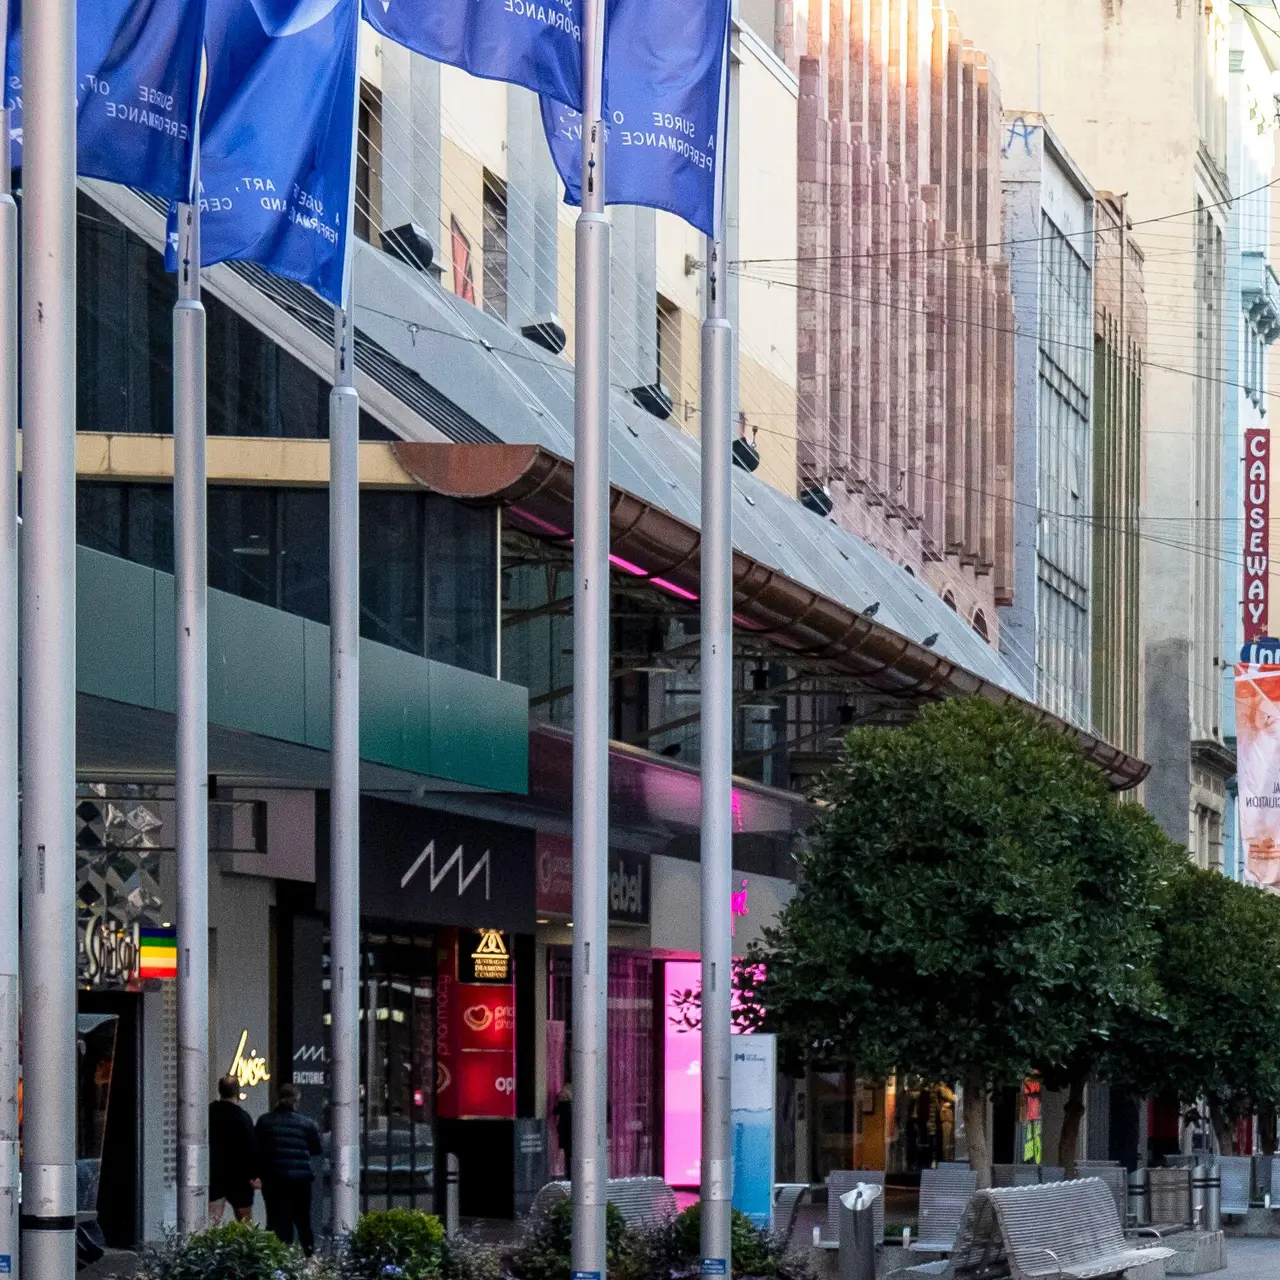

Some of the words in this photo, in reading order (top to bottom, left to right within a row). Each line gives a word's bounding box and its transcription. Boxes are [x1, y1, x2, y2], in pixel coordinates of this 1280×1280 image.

[1247, 436, 1268, 625] CAUSEWAY
[611, 860, 643, 913] ebel
[475, 964, 507, 972] DIAMOND
